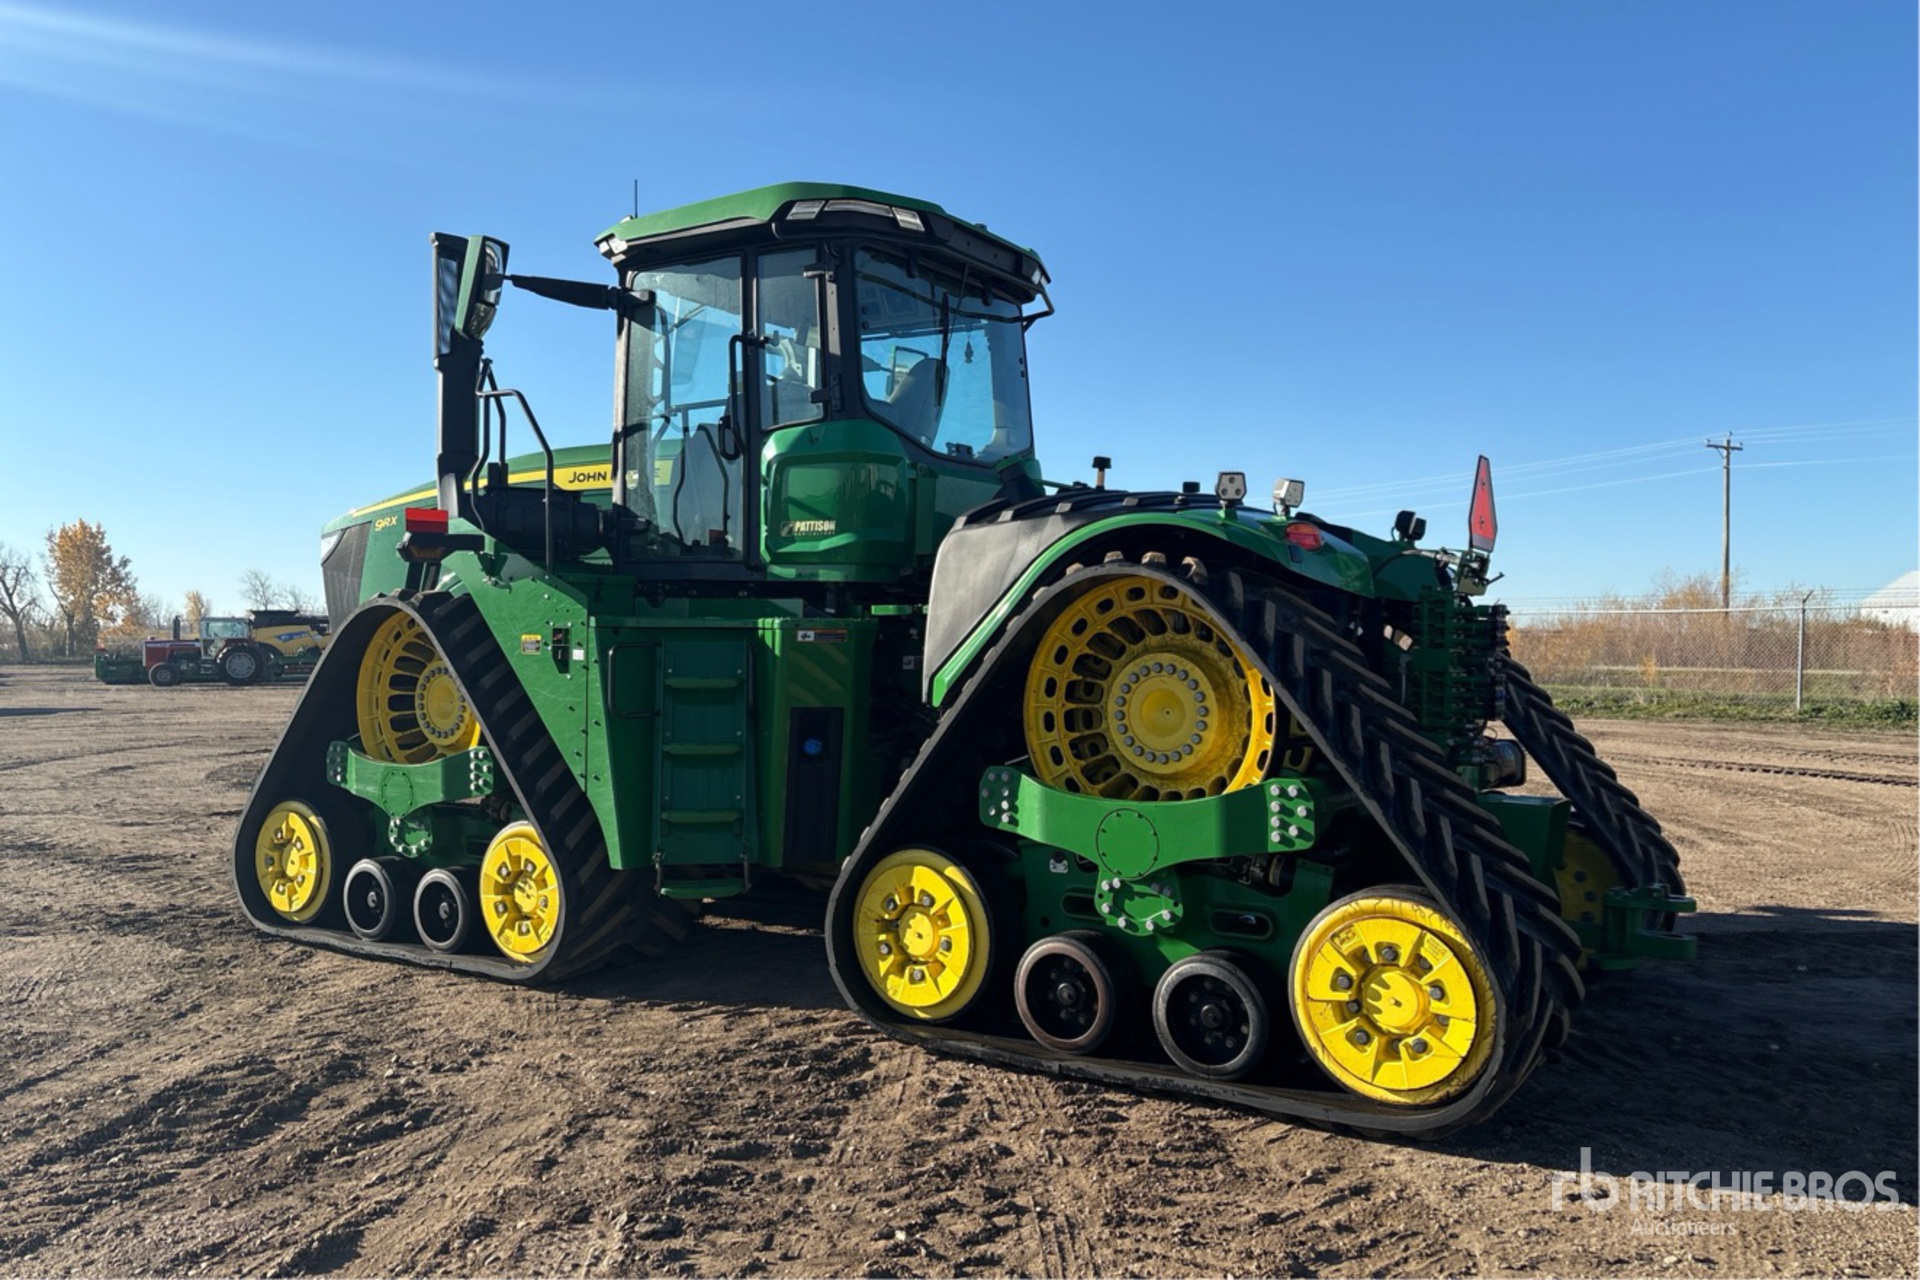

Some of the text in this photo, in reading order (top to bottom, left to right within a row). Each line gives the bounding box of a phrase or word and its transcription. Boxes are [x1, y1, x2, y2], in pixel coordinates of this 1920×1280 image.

[568, 471, 607, 484] JOHN
[374, 515, 398, 531] 9RX
[794, 520, 836, 532] PATTISON
